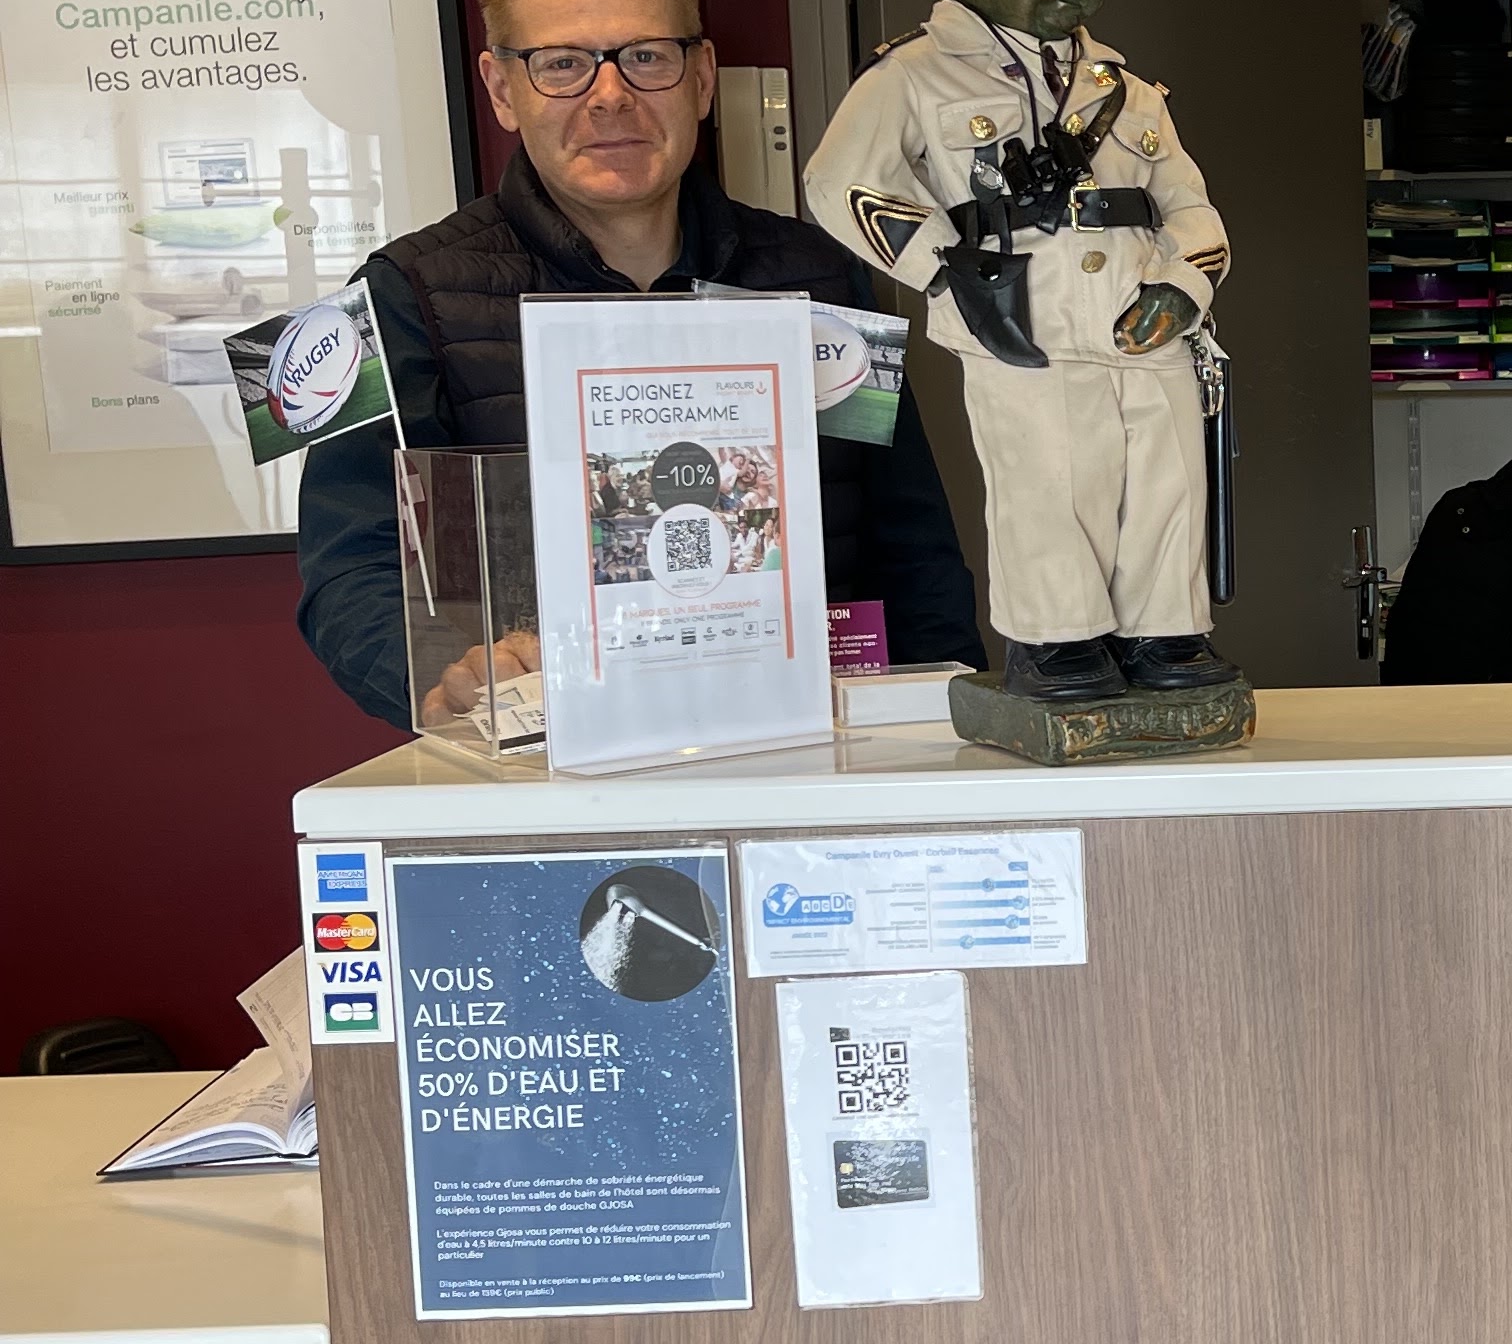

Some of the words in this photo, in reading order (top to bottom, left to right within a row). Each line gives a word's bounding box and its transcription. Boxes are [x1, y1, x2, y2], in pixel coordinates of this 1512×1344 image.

[110, 34, 140, 58] et
[150, 27, 280, 56] cumulez
[87, 66, 130, 92] les
[141, 61, 307, 90] avantages.
[45, 279, 102, 291] Paiement
[72, 293, 87, 303] en
[90, 291, 120, 305] ligne
[291, 328, 340, 388] RUGBY
[91, 396, 123, 408] Bons
[127, 395, 160, 408] plans
[590, 383, 694, 402] REJOIGNEZ
[592, 410, 614, 427] LE
[621, 405, 739, 425] PROGRAMME
[317, 927, 376, 938] MasterCard
[317, 961, 382, 983] VISA
[409, 967, 494, 992] VOUS
[413, 1002, 507, 1027] ALLEZ
[417, 1033, 621, 1063] ÉCONOMISER
[418, 1072, 478, 1097] 50%
[488, 1070, 579, 1096] D'EAU
[589, 1069, 625, 1091] ET
[421, 1102, 584, 1132] D'ÉNERGIE
[434, 1181, 458, 1190] Dans
[461, 1181, 470, 1189] le
[472, 1180, 501, 1189] cadre
[504, 1179, 530, 1188] d'une
[533, 1178, 582, 1187] démarche
[586, 1176, 598, 1184] de
[601, 1175, 642, 1184] sobriété
[645, 1174, 704, 1184] énergétique
[435, 1194, 474, 1202] durable,
[477, 1193, 508, 1201] toutes
[512, 1192, 526, 1200] les
[528, 1191, 556, 1199] salles
[559, 1190, 572, 1198] de
[574, 1189, 596, 1198] bain
[646, 1187, 668, 1195] sont
[670, 1185, 720, 1195] désormais
[436, 1206, 480, 1216] équipées
[483, 1205, 496, 1214] de
[499, 1205, 541, 1215] pommes
[544, 1203, 557, 1212] de
[560, 1201, 596, 1210] douche
[599, 1200, 634, 1210] GJOSA
